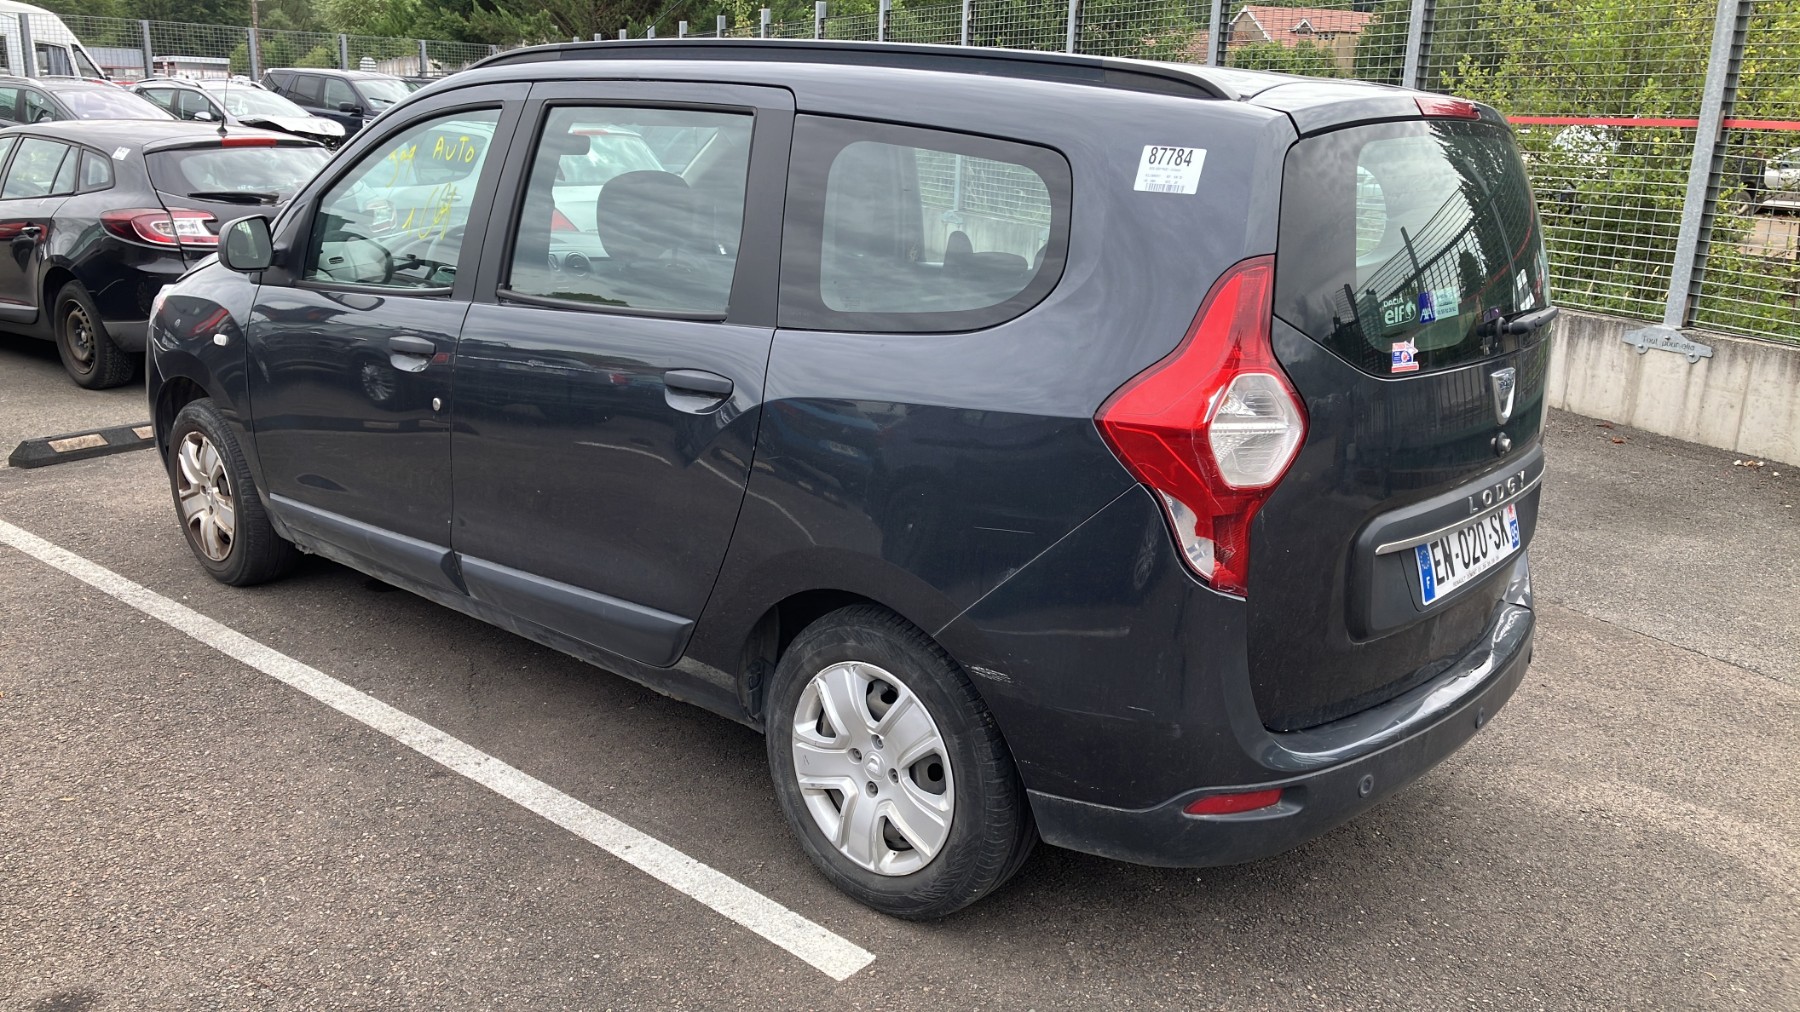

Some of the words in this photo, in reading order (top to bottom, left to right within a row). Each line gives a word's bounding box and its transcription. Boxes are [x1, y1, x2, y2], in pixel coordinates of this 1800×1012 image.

[1148, 146, 1194, 167] 87784
[1383, 296, 1404, 308] DACIA
[1384, 305, 1405, 325] elf
[1419, 307, 1434, 322] AXA
[1468, 470, 1526, 514] LODGY
[1425, 575, 1431, 590] F
